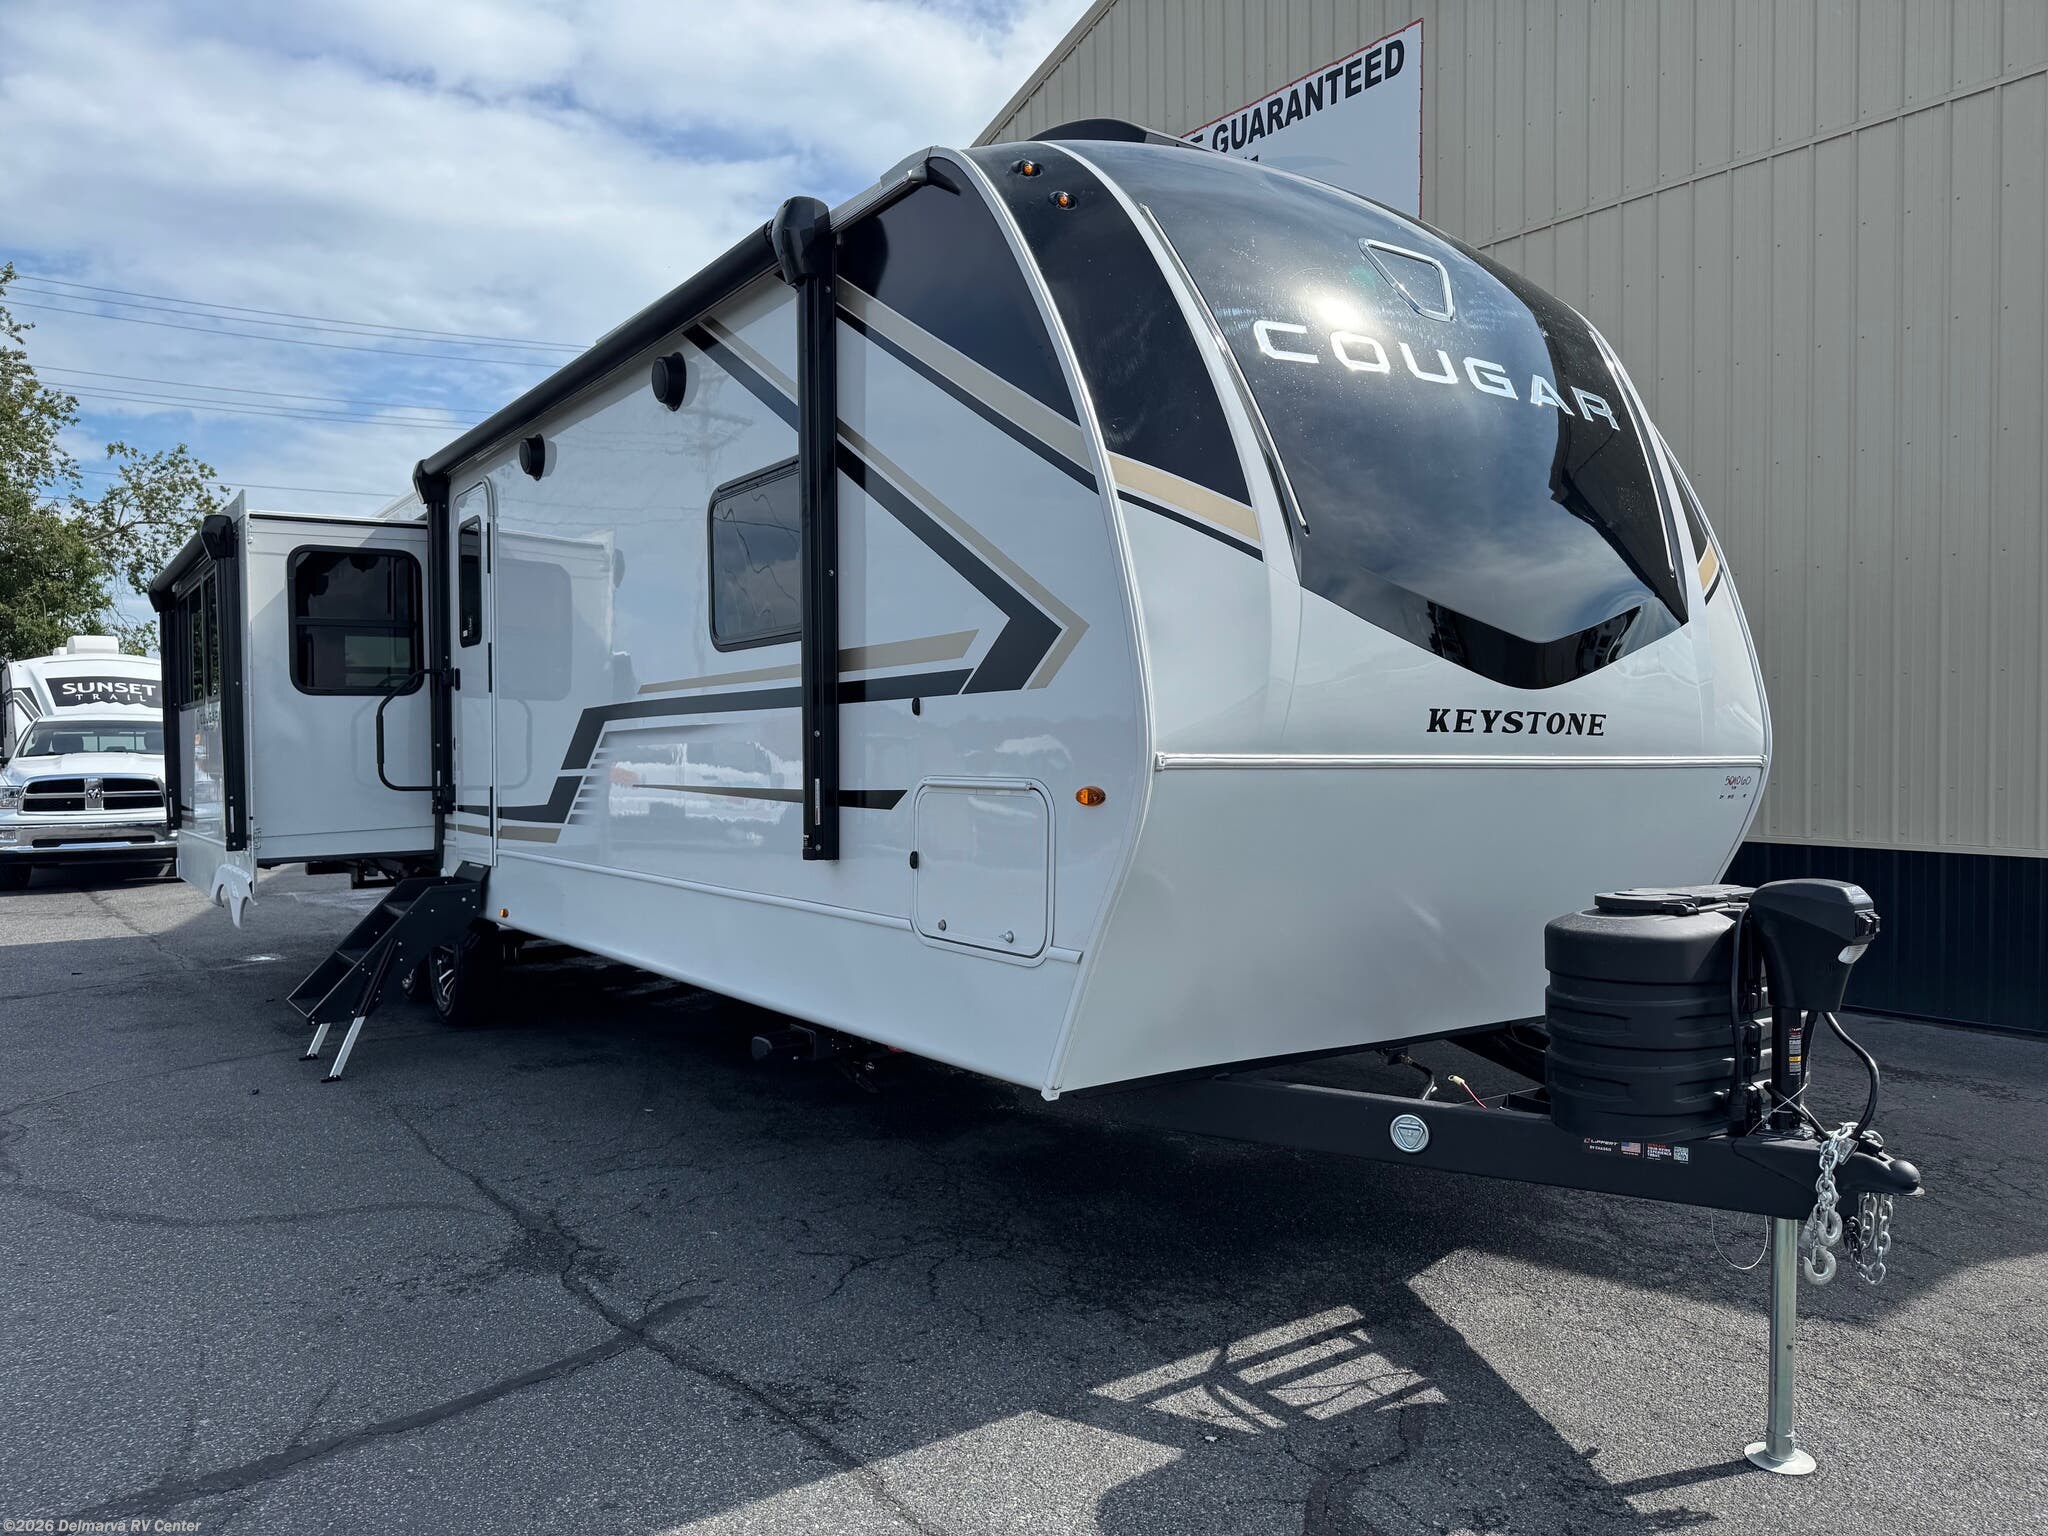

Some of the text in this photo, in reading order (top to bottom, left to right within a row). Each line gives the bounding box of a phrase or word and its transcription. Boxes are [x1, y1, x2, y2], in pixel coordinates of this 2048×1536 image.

[1212, 39, 1405, 153] GUARANTEED
[1252, 319, 1620, 431] COUGAR
[61, 681, 157, 696] SUNSET
[75, 693, 147, 702] TRAIL
[1426, 708, 1607, 737] KEYSTONE
